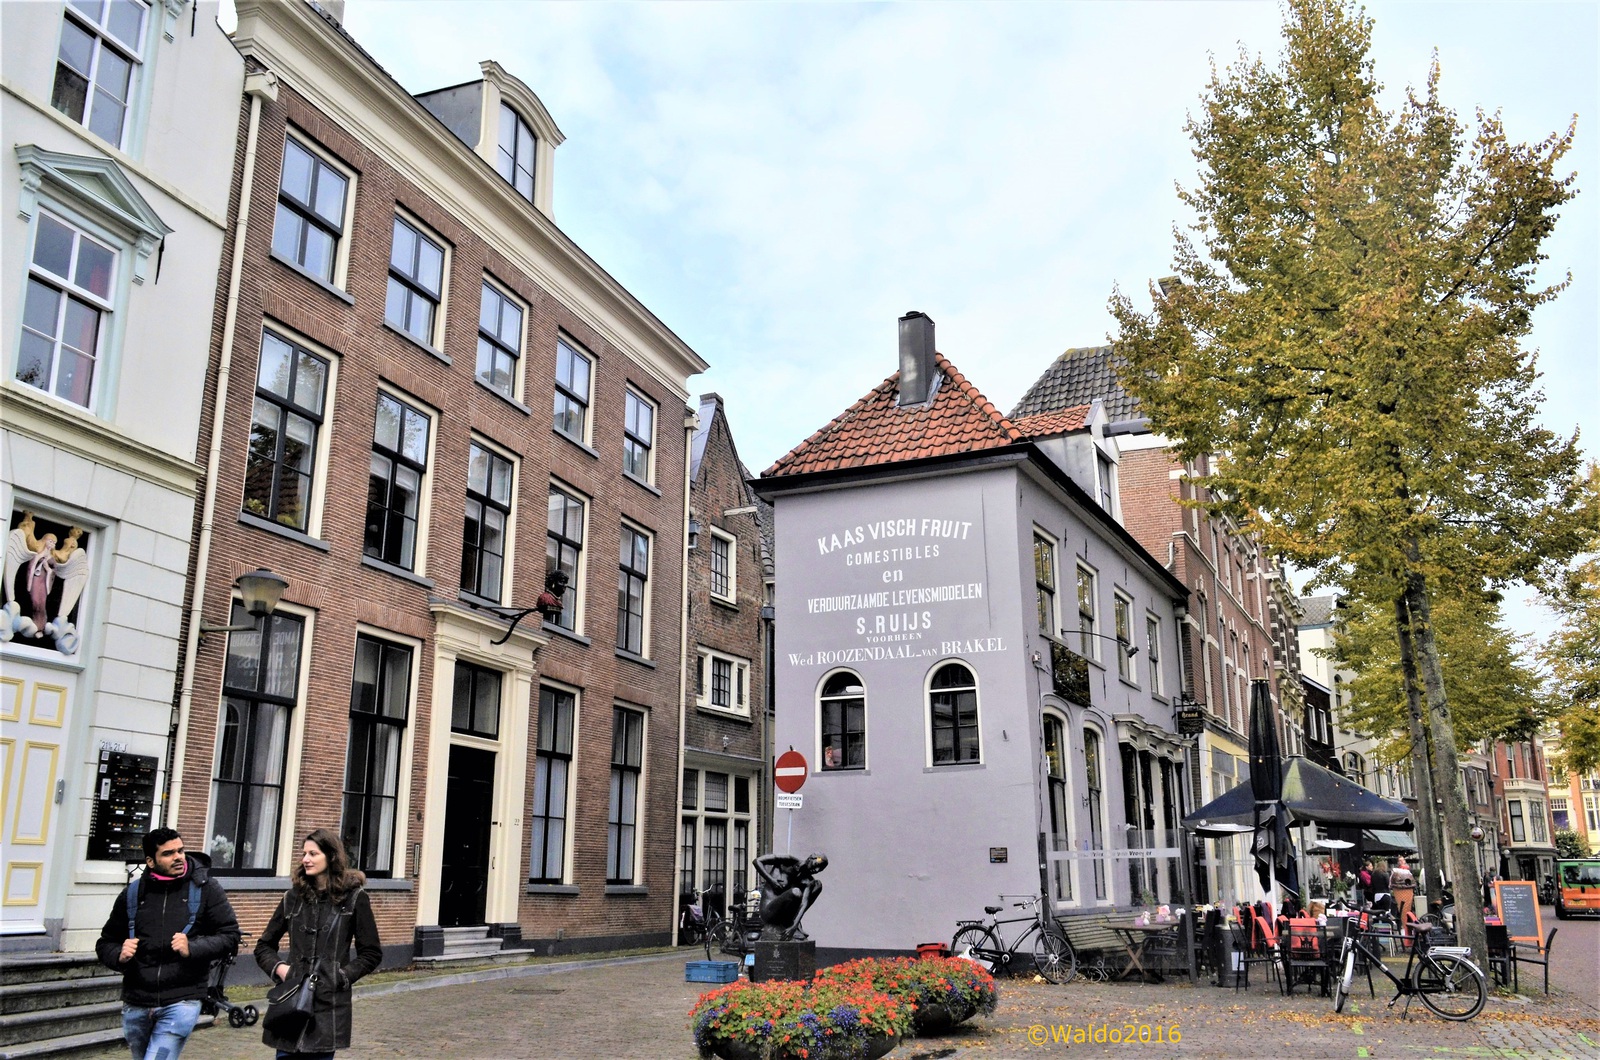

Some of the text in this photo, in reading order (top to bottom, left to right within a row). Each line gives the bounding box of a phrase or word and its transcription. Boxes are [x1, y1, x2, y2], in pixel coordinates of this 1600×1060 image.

[817, 518, 972, 555] KAAS VISCH FRUIT
[846, 544, 940, 566] COMESTIBLES
[882, 569, 903, 583] en
[807, 583, 982, 613] VERDUURZAAMDE LEVENSMIDDELEN
[866, 633, 922, 643] VOORHEEN
[788, 653, 814, 666] Wed
[941, 637, 1007, 655] BRAKEL
